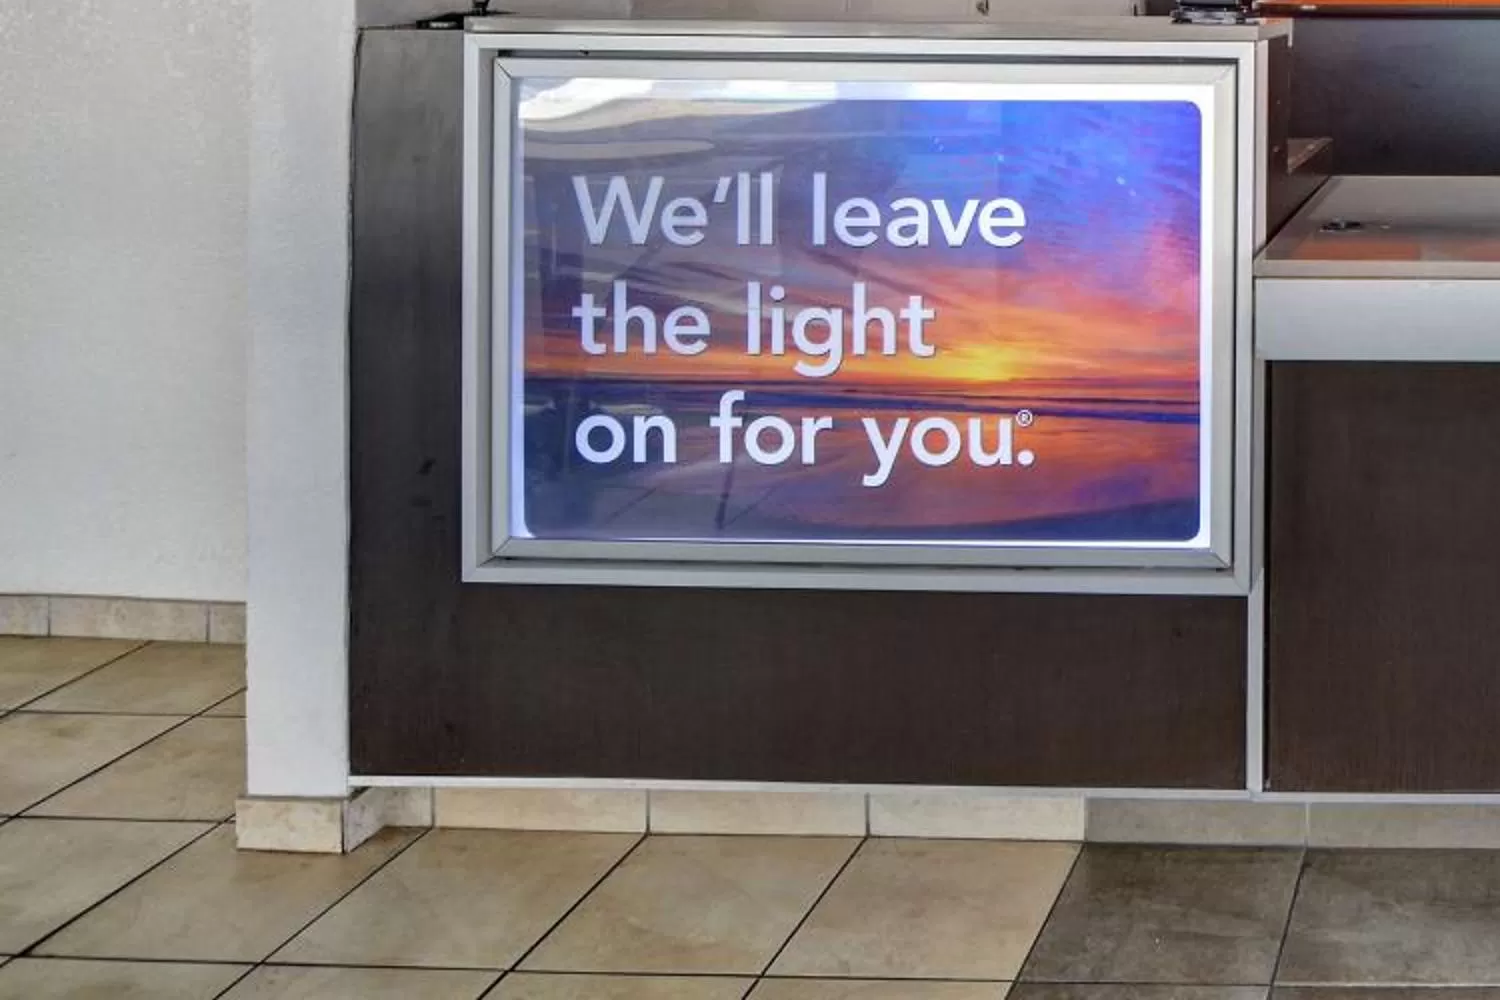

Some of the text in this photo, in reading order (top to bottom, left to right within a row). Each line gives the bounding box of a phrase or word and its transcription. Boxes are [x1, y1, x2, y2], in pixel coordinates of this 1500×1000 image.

[813, 172, 1026, 248] leave
[572, 280, 936, 378] the light
[575, 411, 677, 465] on
[710, 389, 831, 466] for
